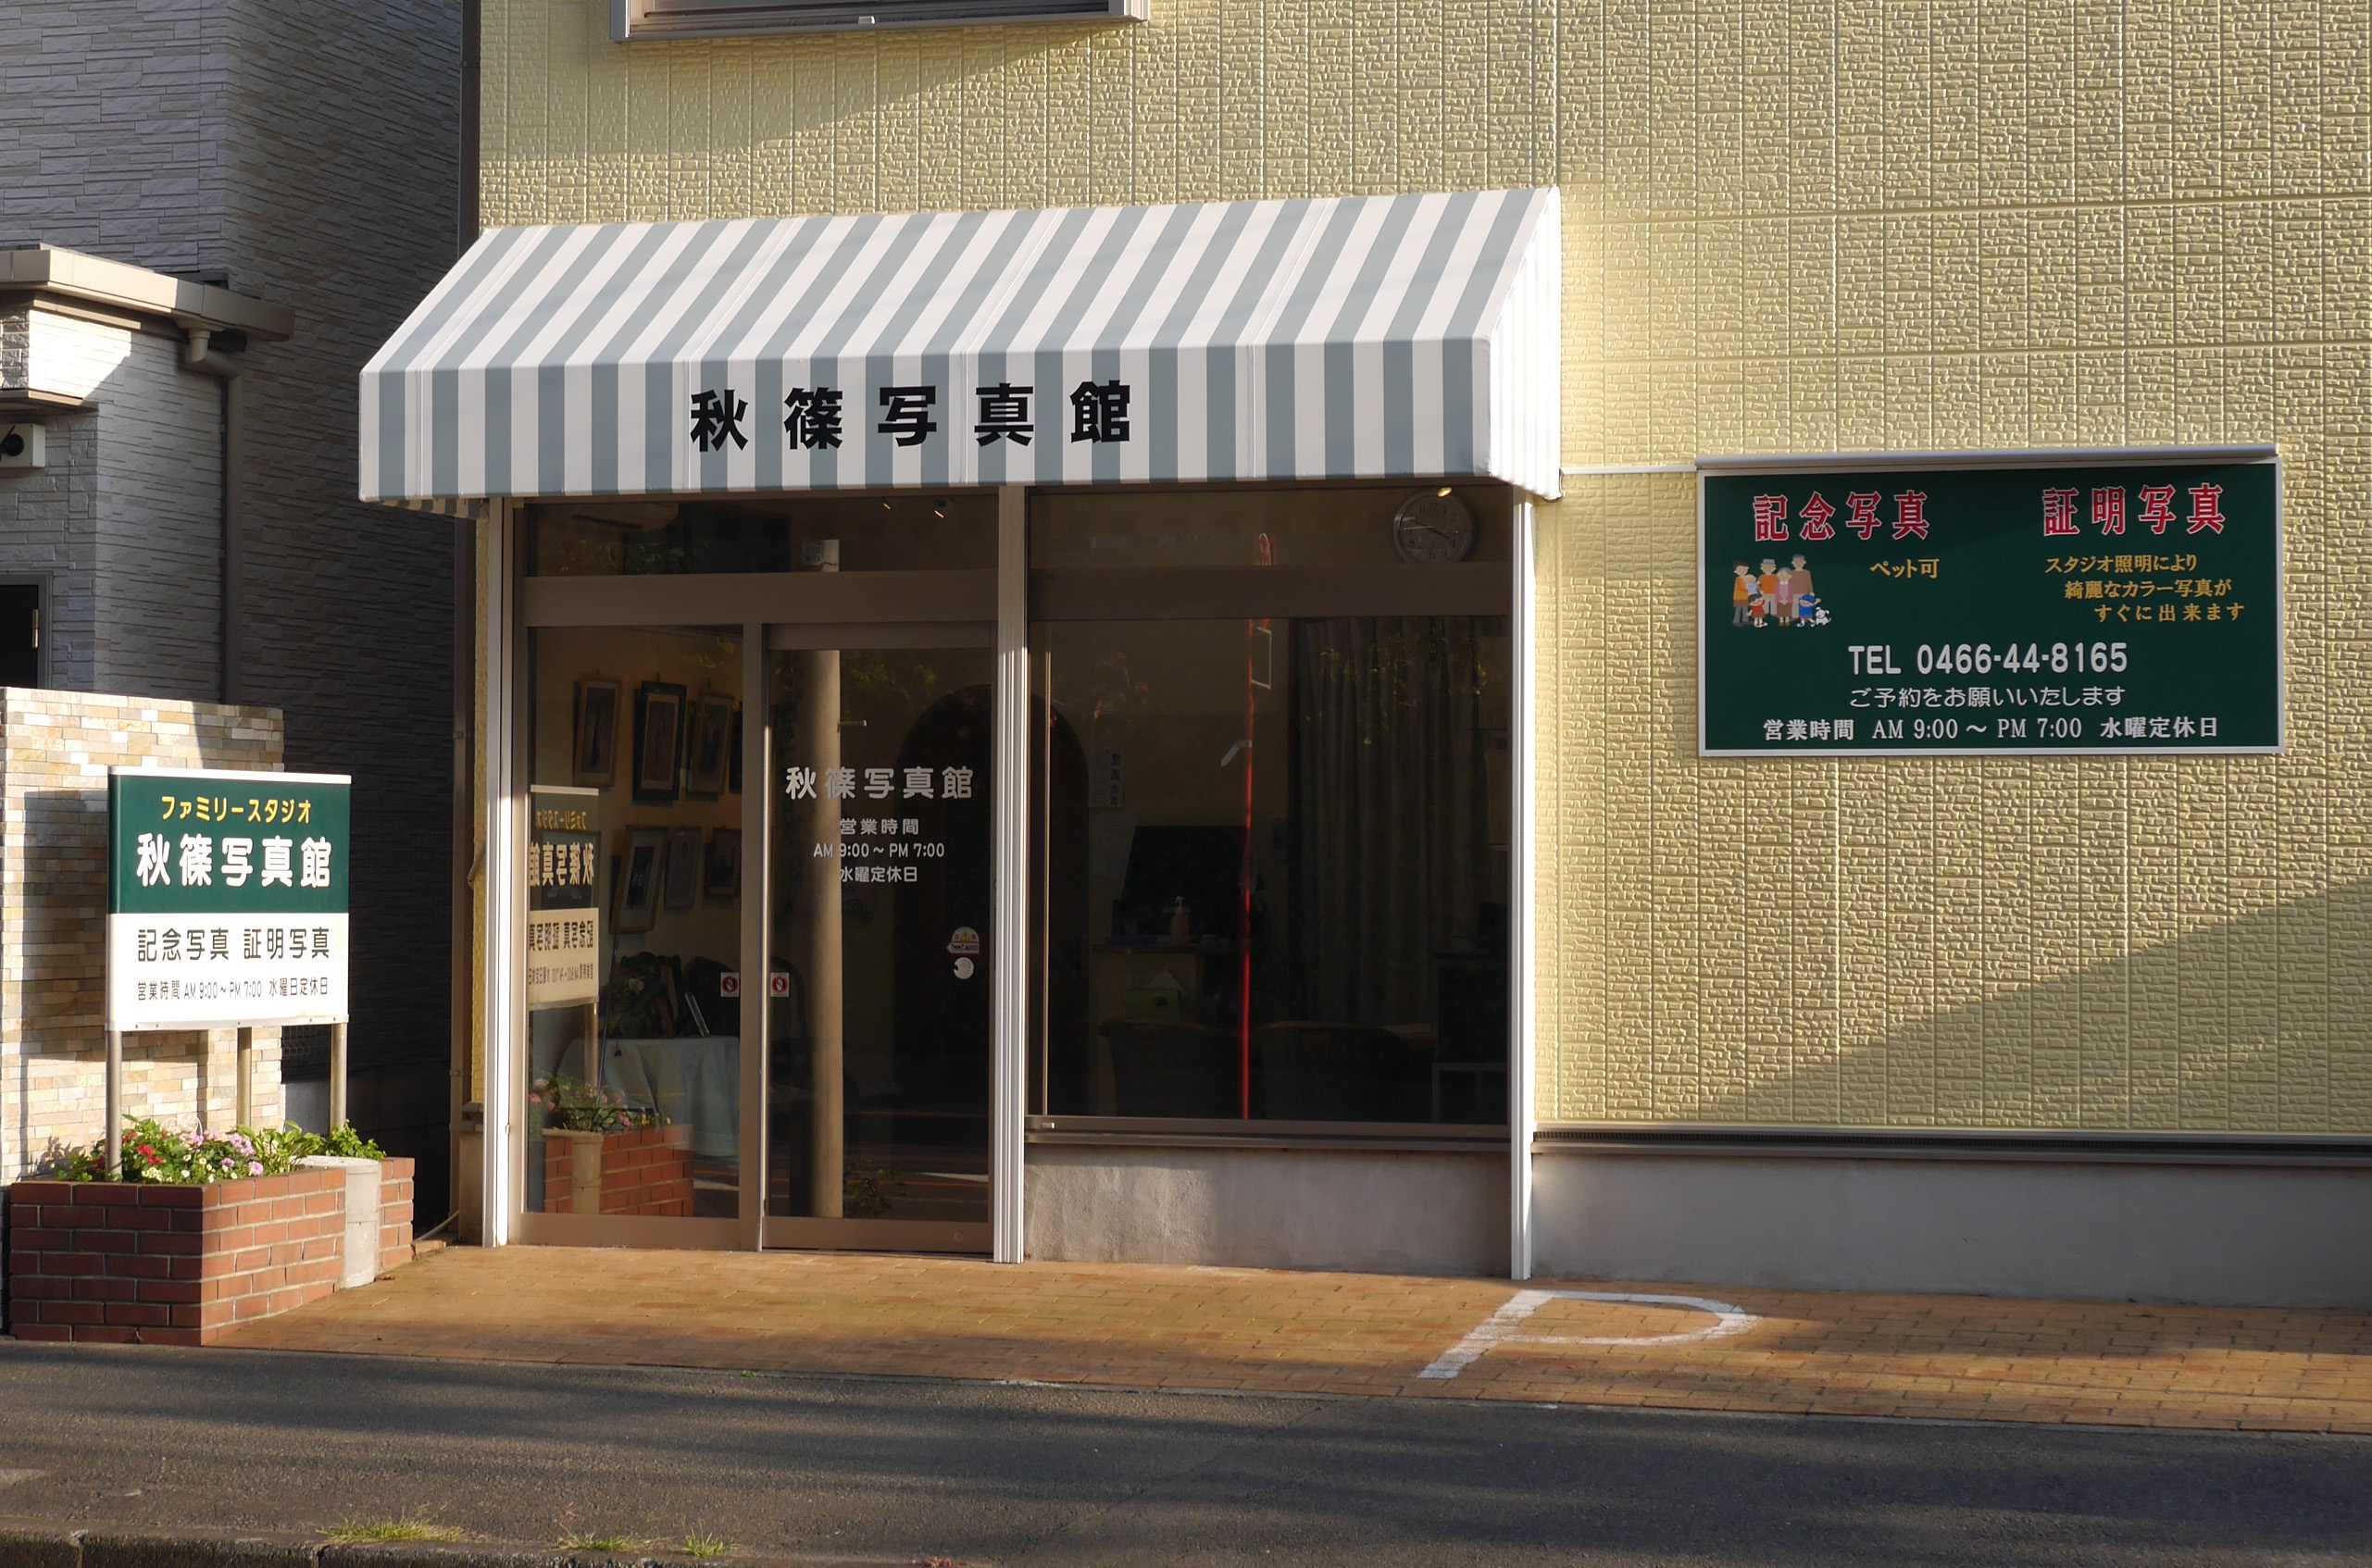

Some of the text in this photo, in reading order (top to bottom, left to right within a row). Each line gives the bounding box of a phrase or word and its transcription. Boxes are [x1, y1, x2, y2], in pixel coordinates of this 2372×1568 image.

[690, 380, 1131, 452] 秋篠写真館
[1753, 490, 1929, 541] 記念写真
[2042, 483, 2226, 536] 証明写真
[1870, 558, 1940, 579] ペット可
[2044, 554, 2198, 574] スタジオ照明により
[2065, 579, 2232, 599] 綺麗なカラー写真が
[2094, 603, 2244, 623] すぐに出来ます
[1848, 642, 2128, 675] TEL 0466-44-8165
[1850, 686, 2126, 708] ご予約をお願いいたします
[1763, 719, 1854, 740] 営業時間
[1872, 720, 1904, 739] AM
[1914, 718, 1958, 739] 9:00
[1997, 718, 2027, 738] PM
[2037, 717, 2082, 738] 7:00
[2100, 716, 2217, 738] 水曜定休日
[786, 766, 973, 800] 秋篠写真館
[161, 796, 311, 824] ファミリースタジオ
[840, 818, 919, 835] 営業時間
[137, 833, 331, 888] 秋篠写真館
[813, 843, 833, 857] AM
[839, 843, 868, 857] 9:00
[889, 843, 908, 857] PM
[913, 843, 944, 857] 7:00
[840, 866, 918, 882] 水曜定休日
[138, 927, 329, 962] 記念写真 証明写真
[138, 980, 180, 1001] 営業時間
[184, 981, 196, 999] AM
[199, 981, 218, 999] 9:00
[230, 981, 241, 998] PM
[243, 980, 262, 998] 7:00
[269, 977, 328, 997] 水曜日定休日
[1417, 1289, 1759, 1379] P
